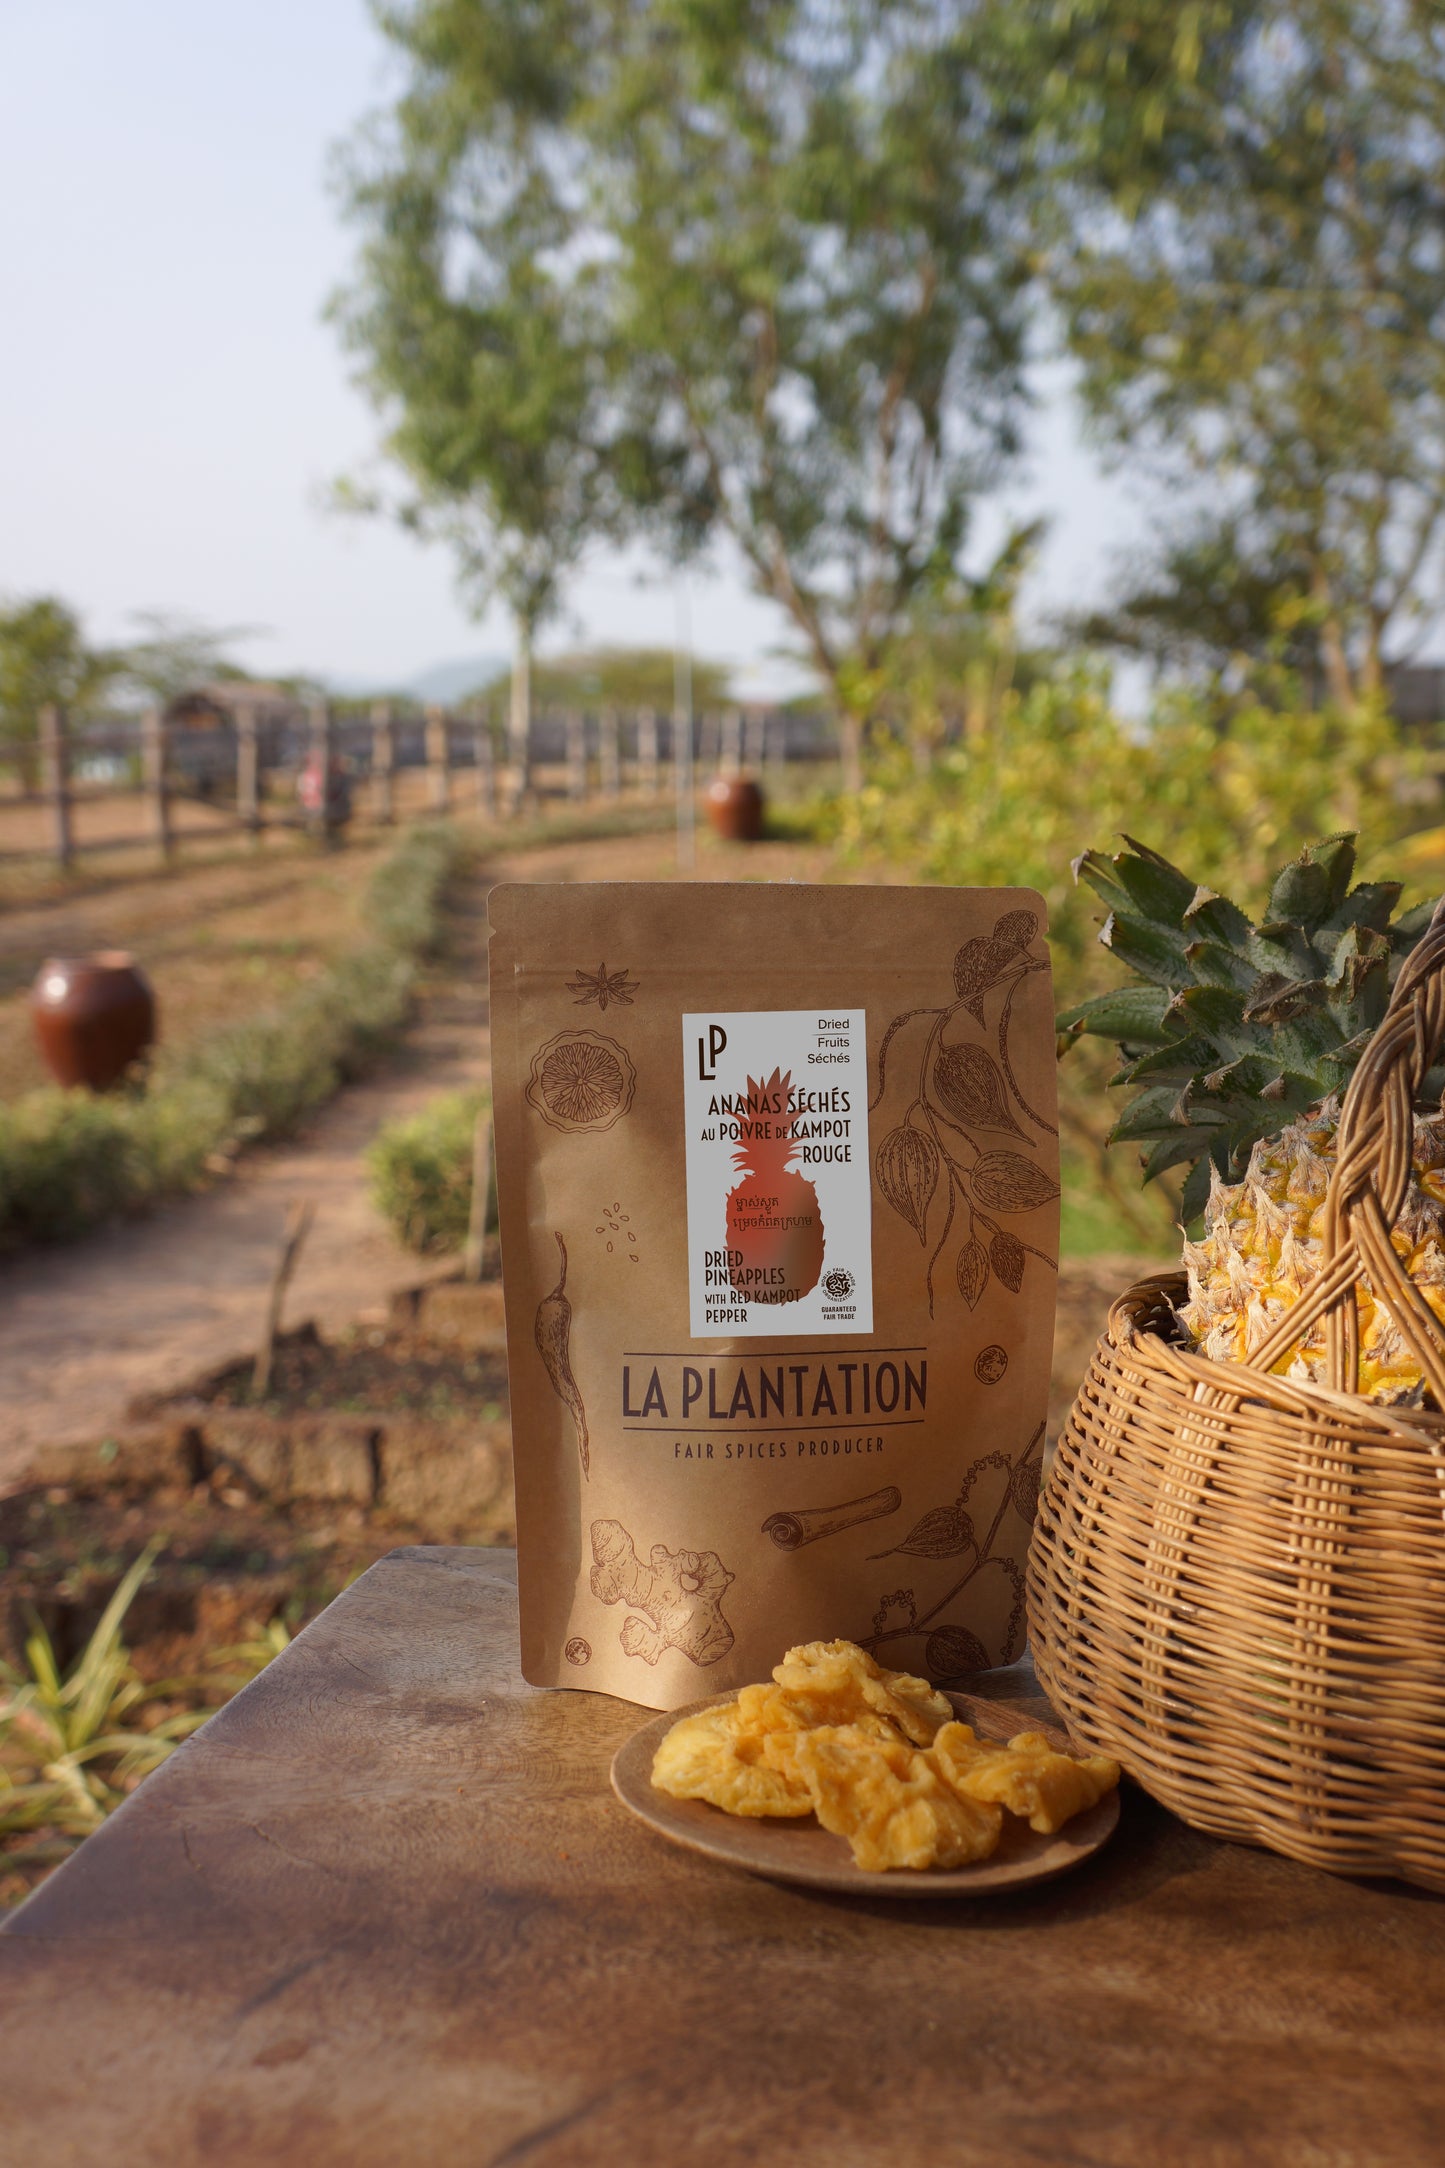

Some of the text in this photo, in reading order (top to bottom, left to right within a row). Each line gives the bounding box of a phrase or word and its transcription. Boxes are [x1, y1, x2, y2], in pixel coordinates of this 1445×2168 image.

[818, 1019, 850, 1029] Dried
[818, 1038, 850, 1048] Fruits
[698, 1025, 727, 1081] LP
[807, 1053, 850, 1064] Séchés
[708, 1087, 851, 1115] ANANAS SÉCHÉS
[701, 1120, 851, 1141] AU POIVRE DE KAMPOT
[803, 1145, 852, 1163] ROUGE
[705, 1251, 744, 1267] DRIED
[705, 1268, 785, 1286] PINEAPPLES
[821, 1270, 832, 1288] WORLD
[845, 1270, 856, 1287] TRADE
[705, 1289, 801, 1304] WITH RED KAMPOT
[706, 1309, 748, 1323] PEPPER
[622, 1359, 927, 1419] LA PLANTATION
[674, 1436, 884, 1459] FAIR SPICES PRODUCER
